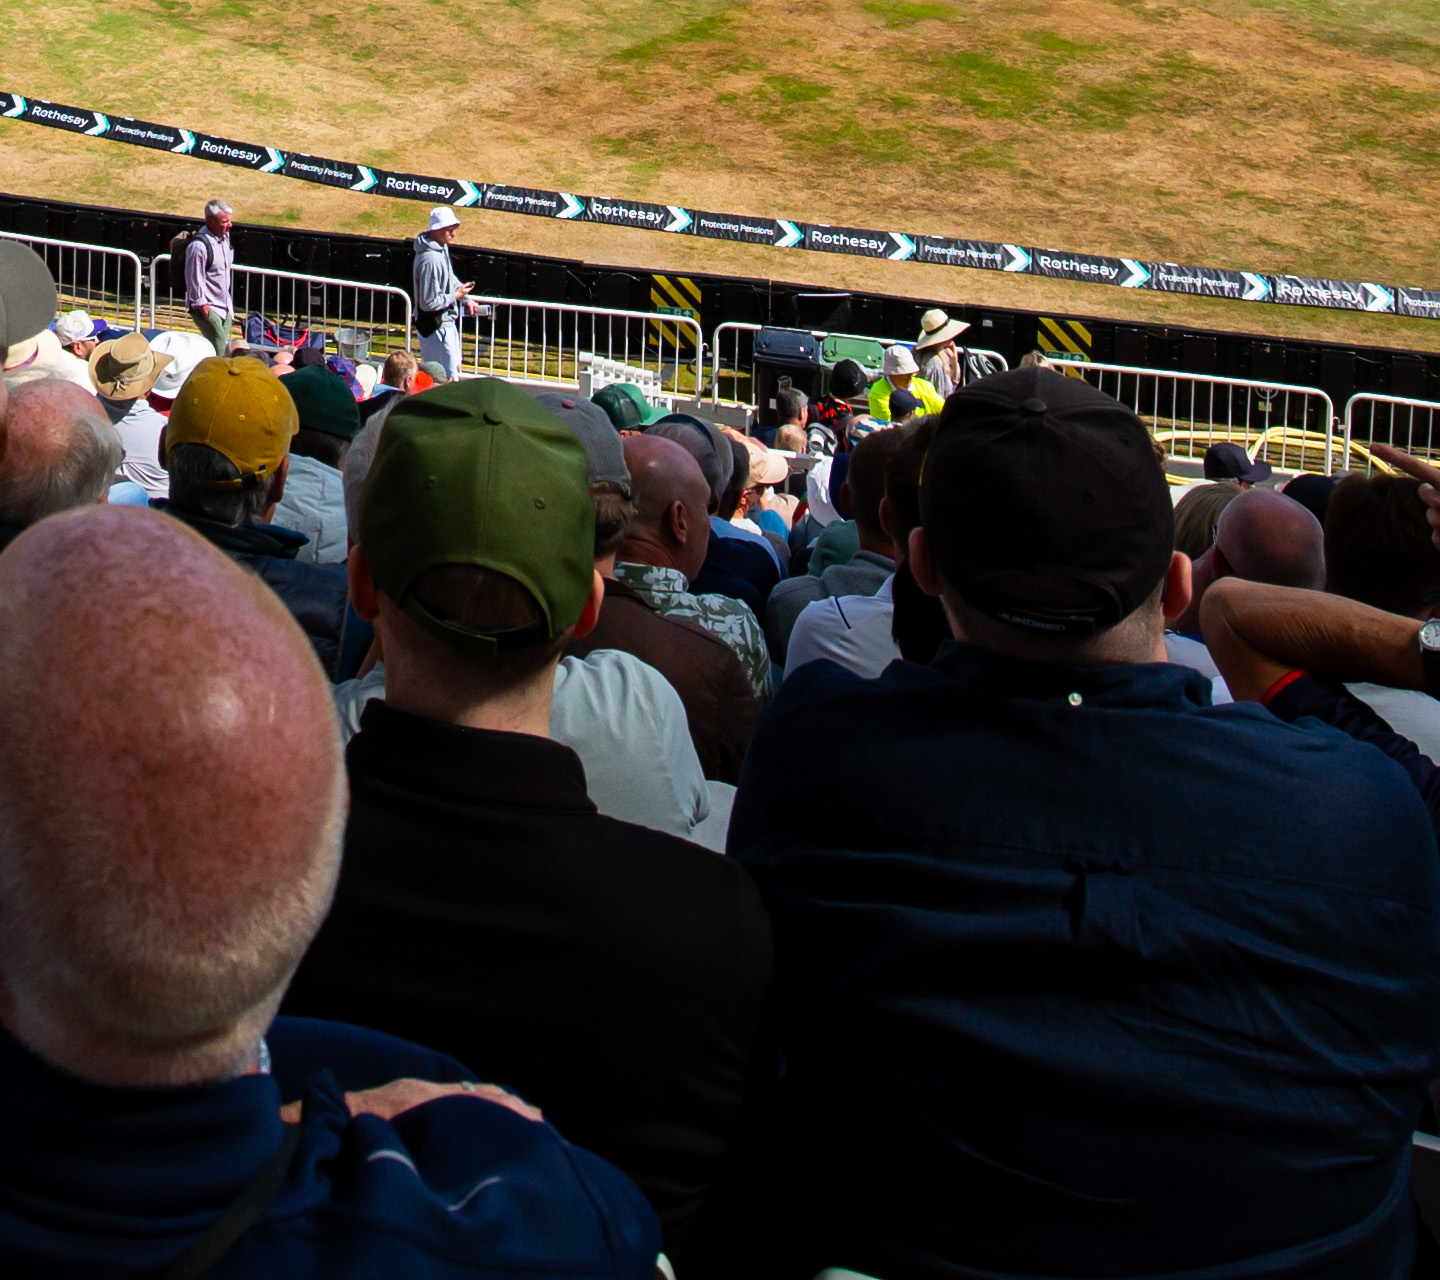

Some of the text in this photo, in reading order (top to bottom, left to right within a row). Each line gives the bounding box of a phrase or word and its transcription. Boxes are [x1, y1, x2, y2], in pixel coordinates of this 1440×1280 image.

[32, 105, 89, 128] Rothesay
[201, 140, 261, 164] Rothesay
[291, 160, 353, 180] Protecting Pensions
[386, 176, 454, 198] Rothesay
[487, 191, 556, 208] Protecting Pensions
[593, 201, 664, 223] Rothesay
[700, 219, 774, 236] Protecting Pensions
[812, 230, 887, 252] Rothesay
[924, 244, 1001, 261] Protecting Pensions
[1040, 255, 1119, 279] Rothesay
[1159, 272, 1239, 290] Protecting Pensions
